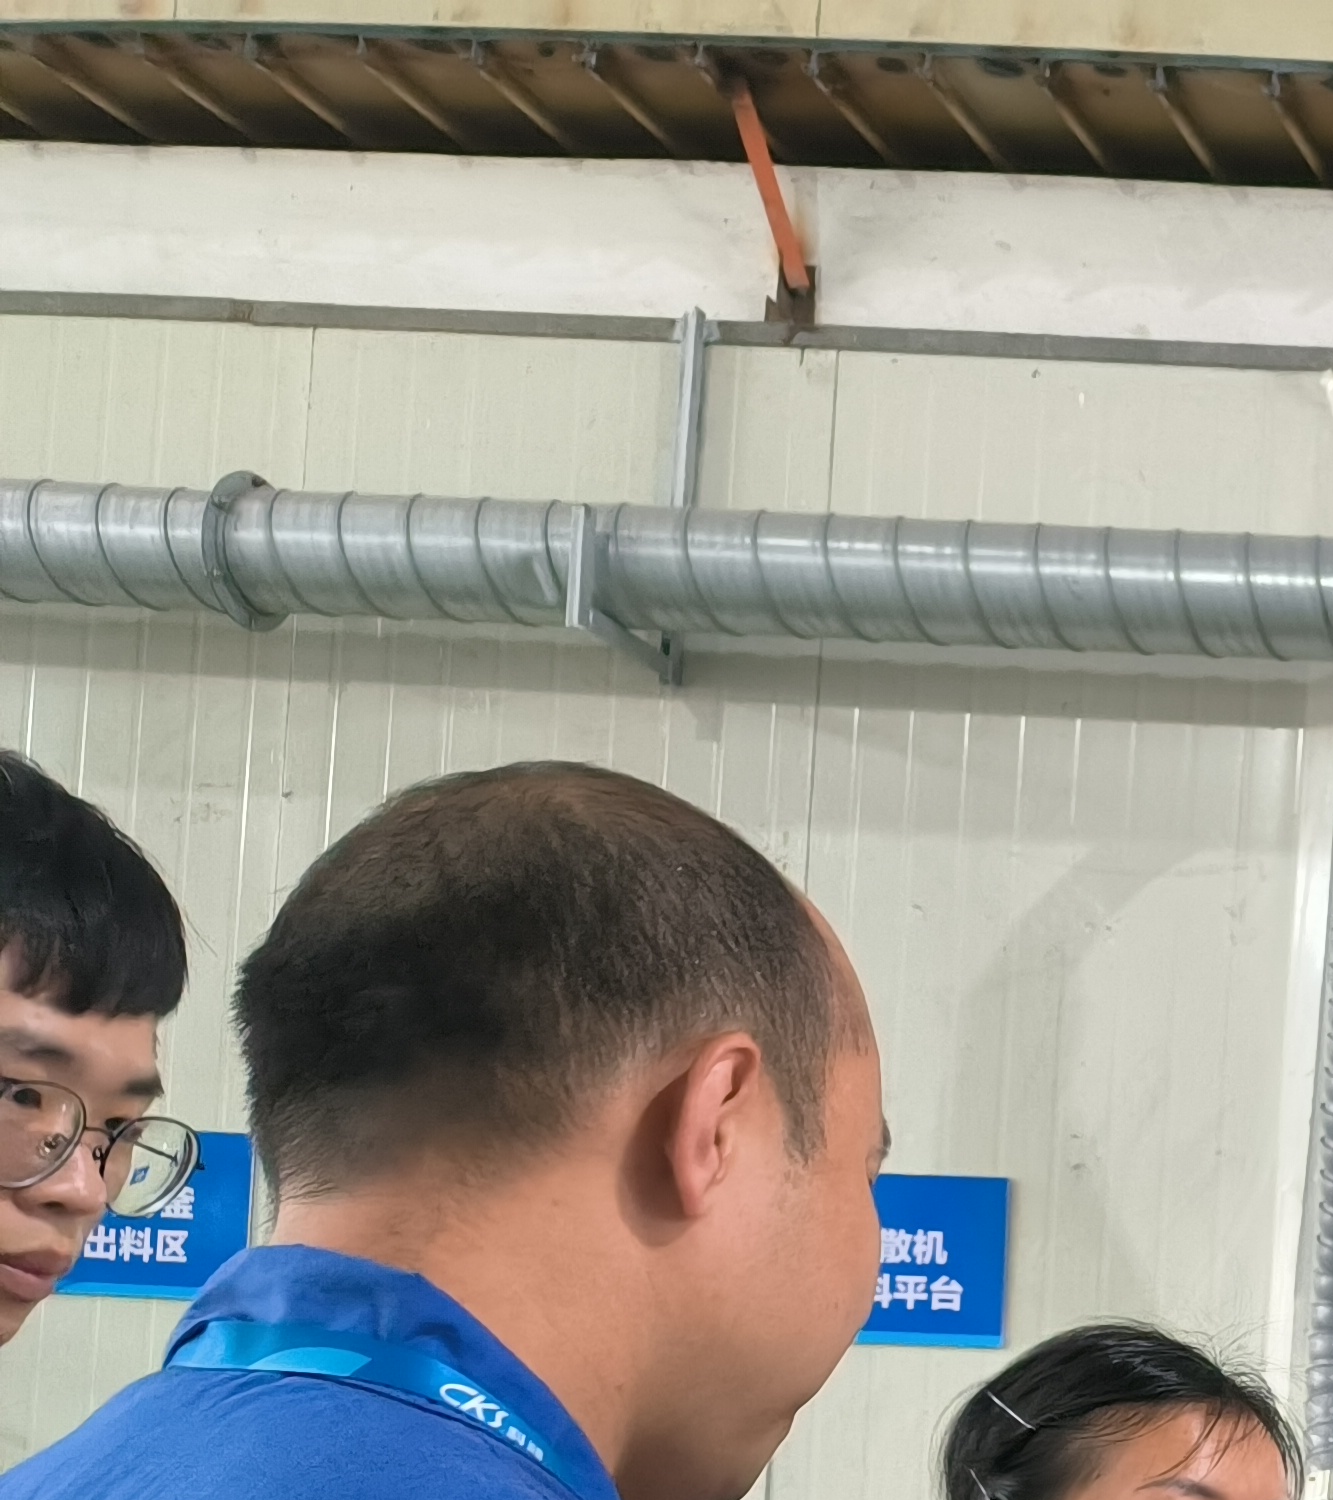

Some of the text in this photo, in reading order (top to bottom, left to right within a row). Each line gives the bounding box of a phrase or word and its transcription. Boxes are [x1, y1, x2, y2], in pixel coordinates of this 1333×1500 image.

[83, 1224, 189, 1263] 出料区
[439, 1383, 510, 1428] CKS
